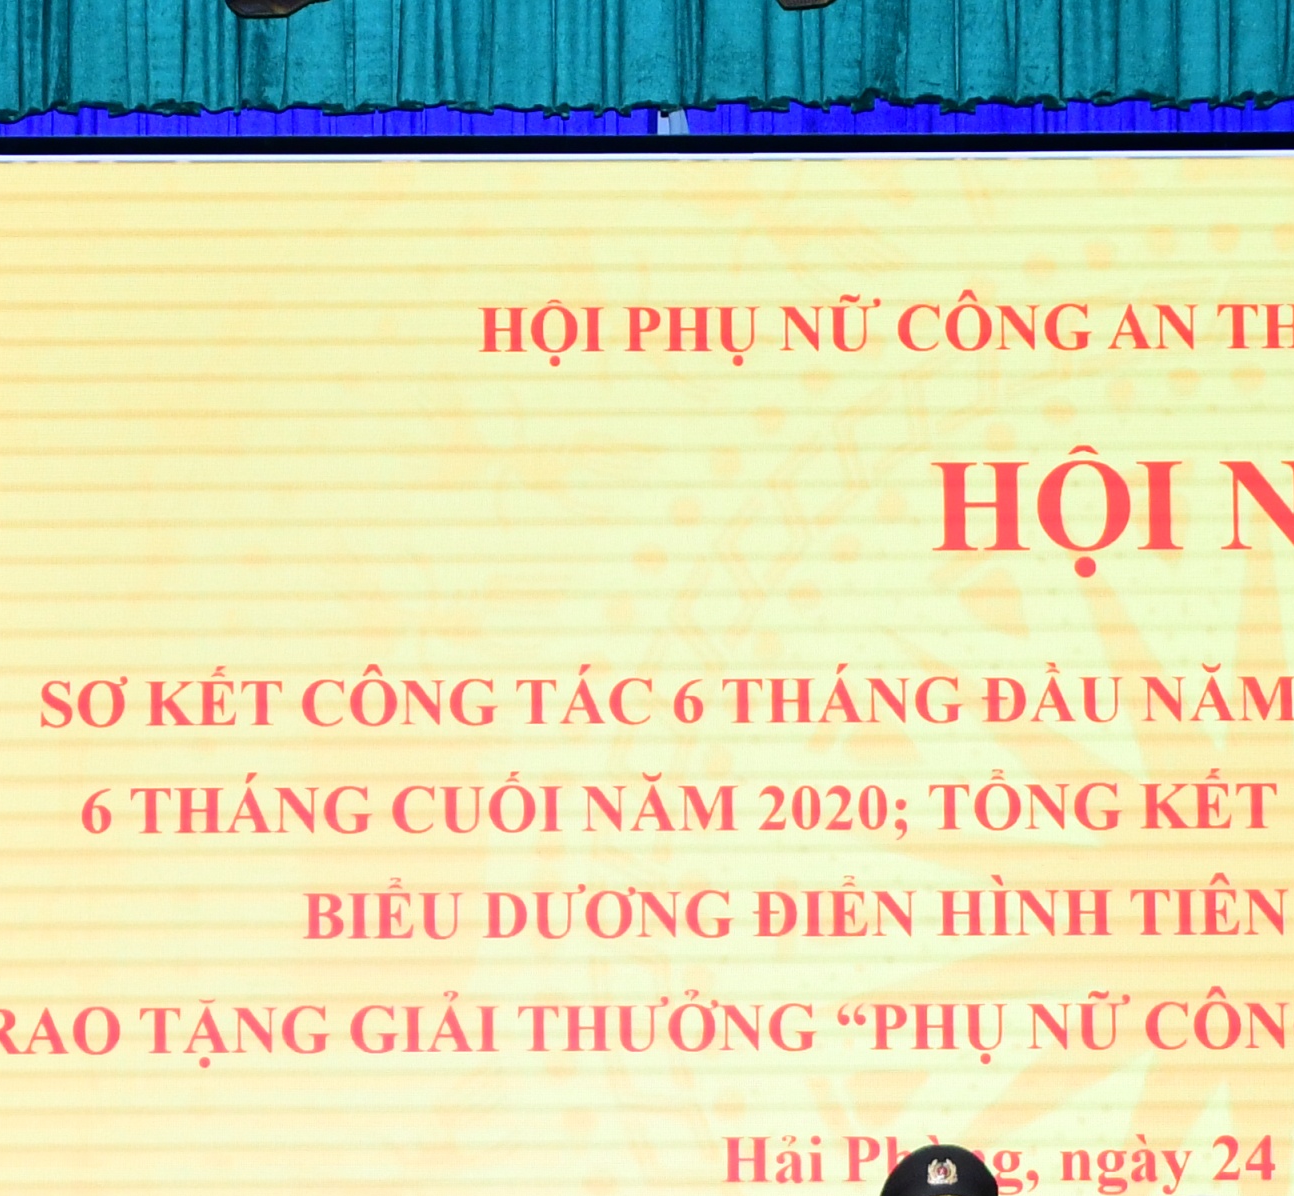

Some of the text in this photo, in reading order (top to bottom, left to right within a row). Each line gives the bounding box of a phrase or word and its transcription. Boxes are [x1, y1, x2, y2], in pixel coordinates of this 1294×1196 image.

[481, 298, 603, 367] HỘI
[626, 306, 757, 367] PHỤ
[781, 293, 882, 353] NỮ
[897, 288, 1091, 352] CÔNG
[1108, 303, 1197, 350] AN
[931, 444, 1184, 579] HỘI
[40, 675, 129, 729] SƠ
[148, 665, 283, 727] KẾT
[301, 663, 497, 728] CÔNG
[515, 663, 653, 726] TÁC
[673, 679, 704, 724] 6
[722, 662, 963, 724] THÁNG
[982, 661, 1121, 723] ĐẦU
[81, 788, 113, 835] 6
[130, 771, 371, 835] THÁNG
[391, 771, 561, 834] CUỐI
[583, 772, 736, 832] NĂM
[759, 784, 908, 839] 2020;
[928, 775, 1122, 831] TỔNG
[1142, 767, 1278, 830] KẾT
[305, 883, 462, 940] BIỂU
[486, 883, 732, 940] DƯƠNG
[754, 881, 913, 937] ĐIỂN
[941, 874, 1111, 937] HÌNH
[1129, 872, 1288, 936] TIÊN
[139, 999, 329, 1069] TẶNG
[349, 990, 497, 1054] GIẢI
[517, 989, 815, 1053] THƯỞNG
[837, 1003, 1005, 1065] “PHỤ
[1029, 990, 1131, 1051] NỮ
[725, 1134, 823, 1184] Hải
[842, 1134, 1040, 1196] Phg,
[1061, 1133, 1185, 1196] ngày
[1213, 1134, 1276, 1182] 24
